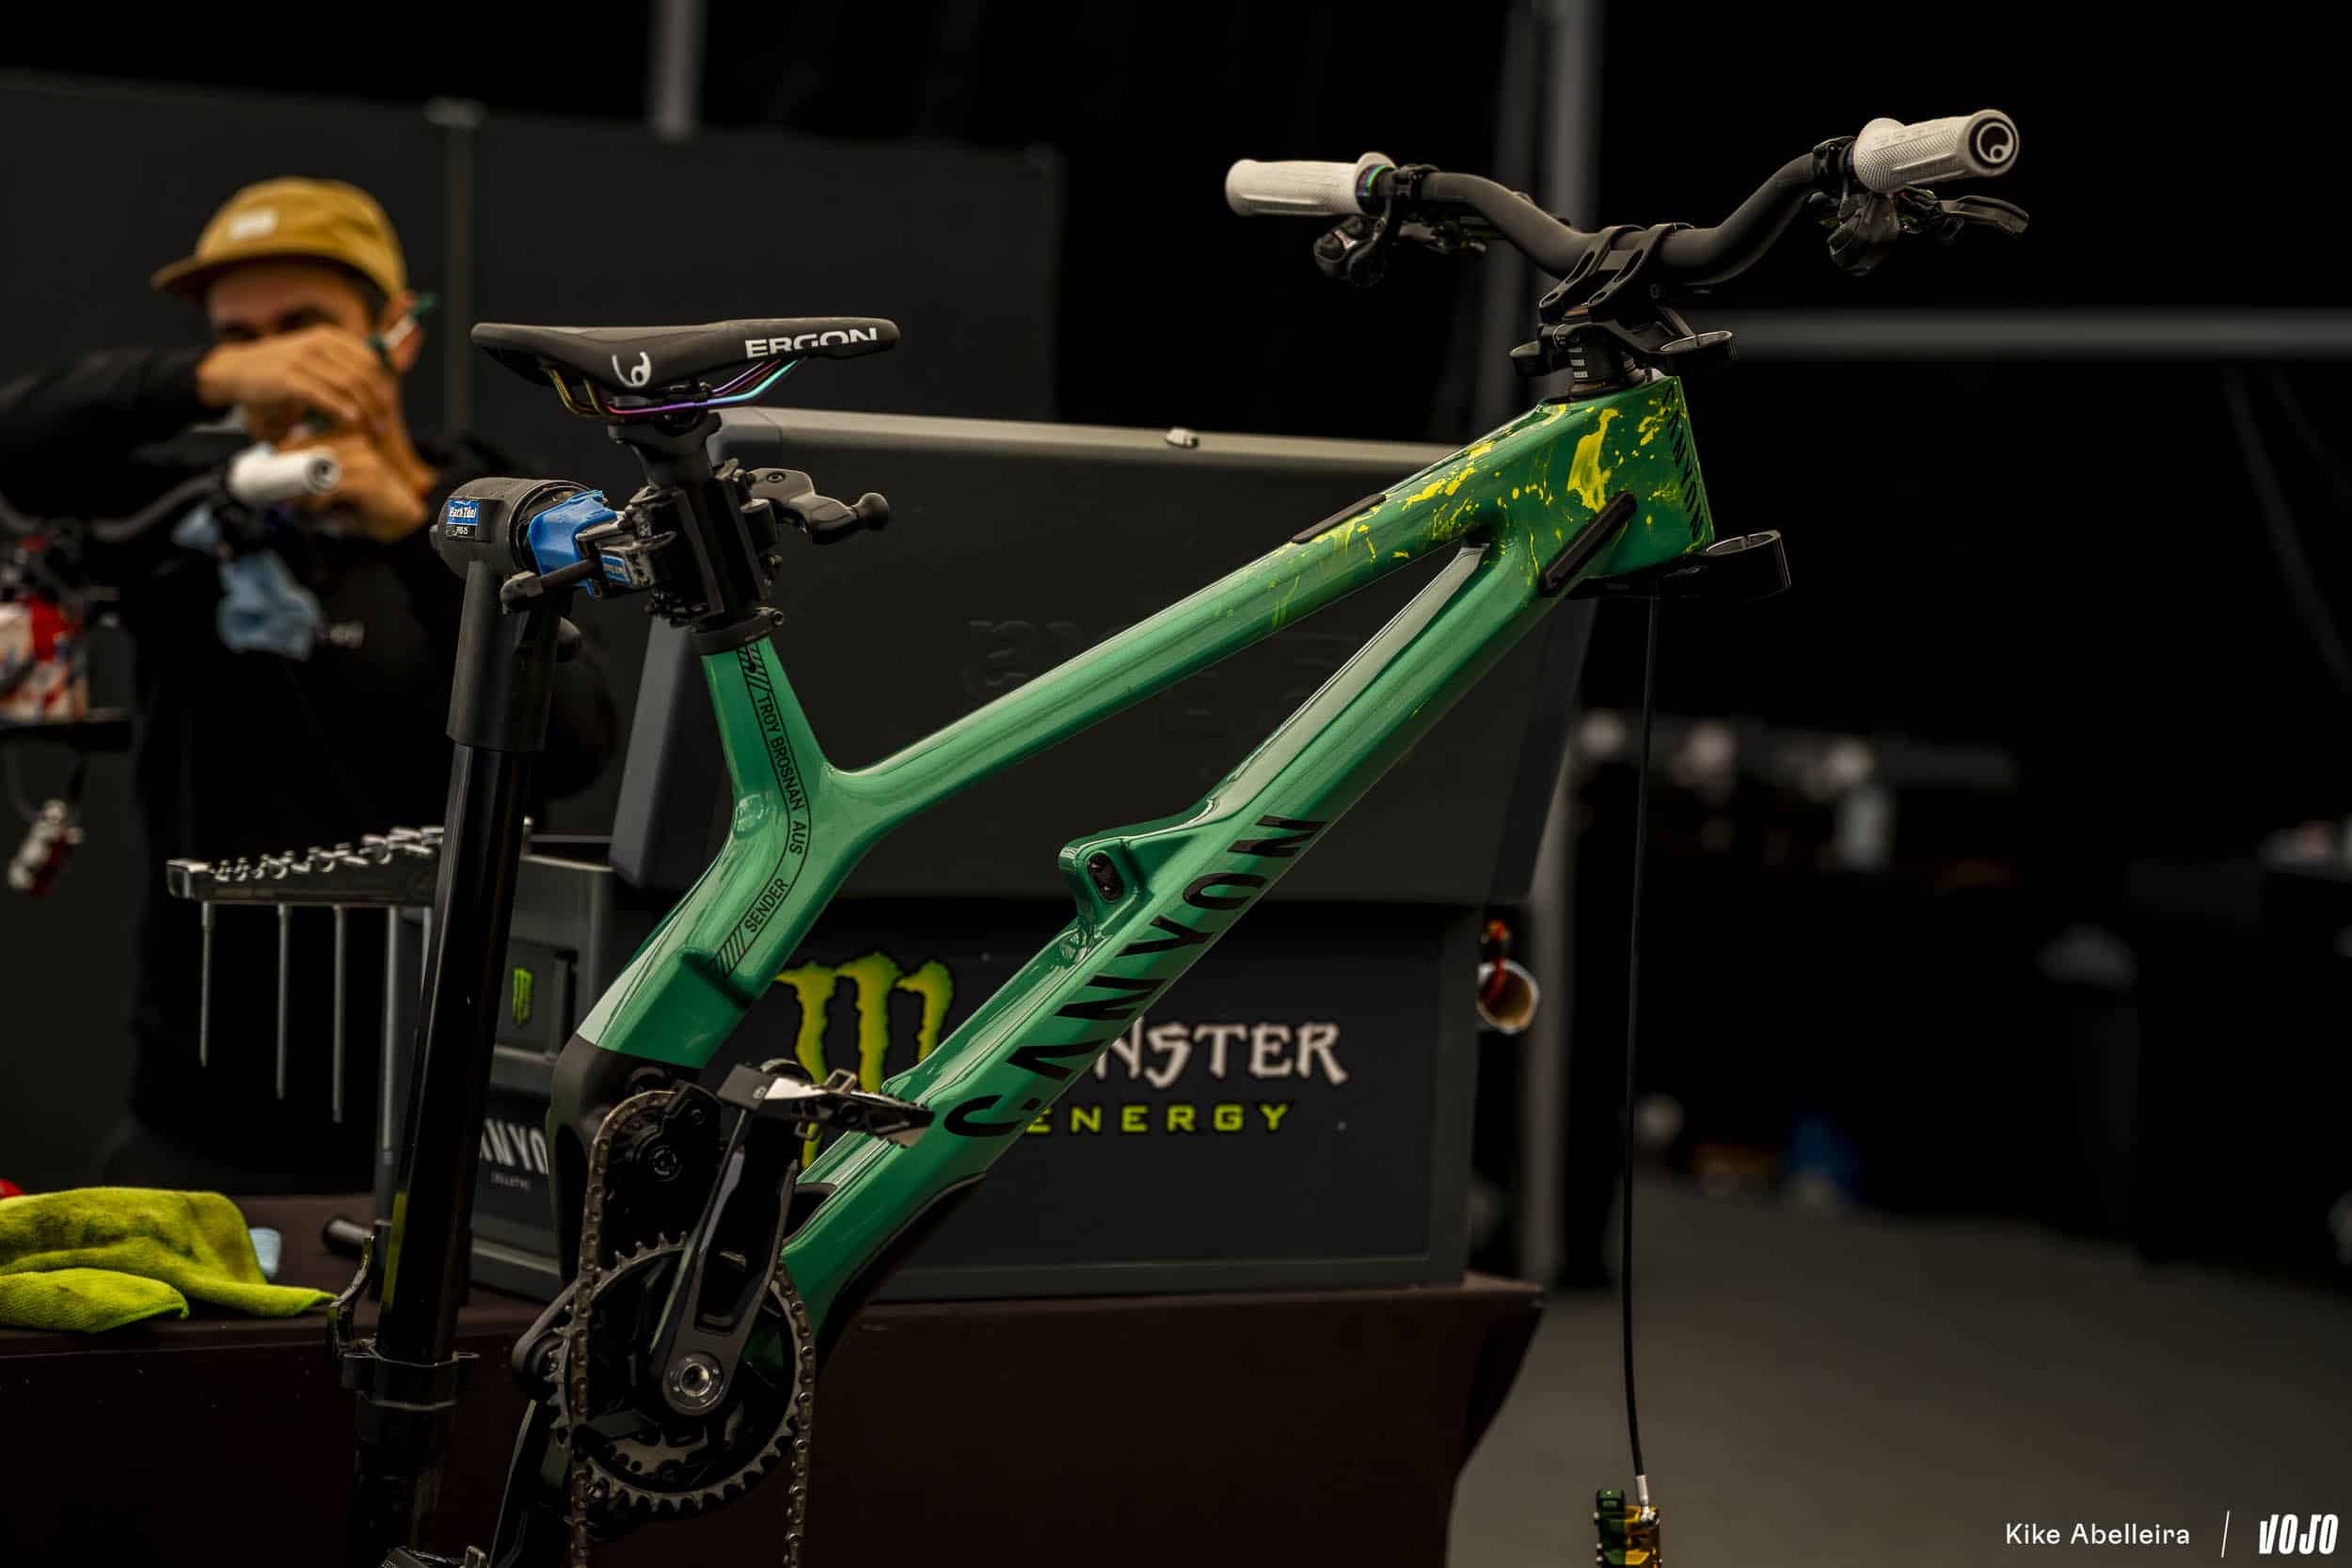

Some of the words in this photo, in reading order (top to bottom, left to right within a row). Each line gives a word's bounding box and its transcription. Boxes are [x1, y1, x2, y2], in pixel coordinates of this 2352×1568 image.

[744, 327, 878, 359] ERGON
[756, 694, 781, 733] TROY
[771, 737, 805, 811] BROSNAN
[789, 820, 807, 855] AUS
[744, 878, 788, 933] SENDER
[944, 815, 1327, 1137] CANYON
[1093, 1016, 1351, 1089] NSTER
